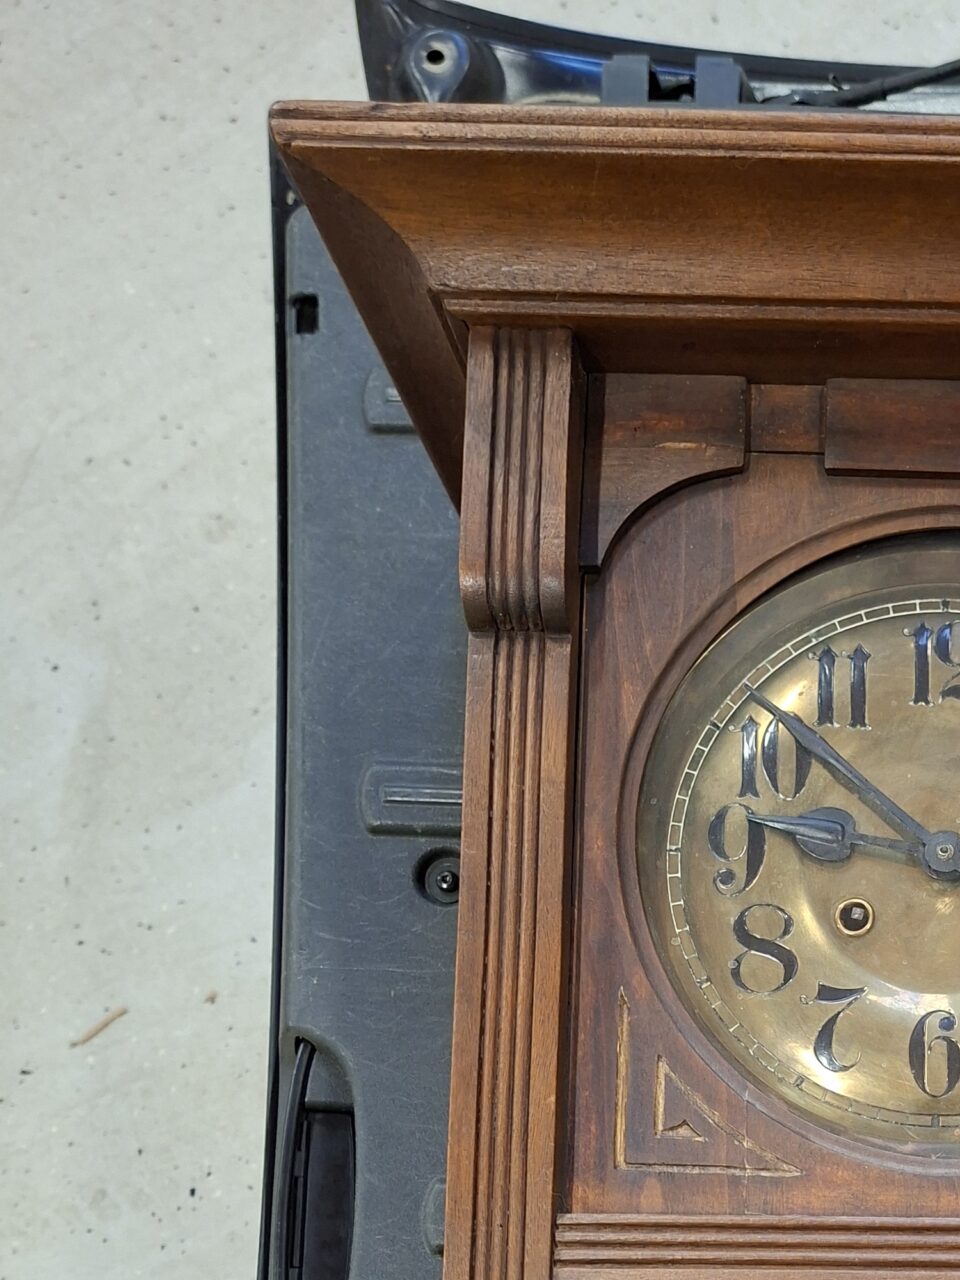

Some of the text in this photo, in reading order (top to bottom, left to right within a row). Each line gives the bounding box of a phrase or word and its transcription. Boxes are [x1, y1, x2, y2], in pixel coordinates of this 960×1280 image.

[809, 643, 872, 730] 11
[729, 712, 813, 801] 10
[707, 802, 766, 896] 9
[730, 903, 799, 994] 8
[800, 980, 869, 1073] 7
